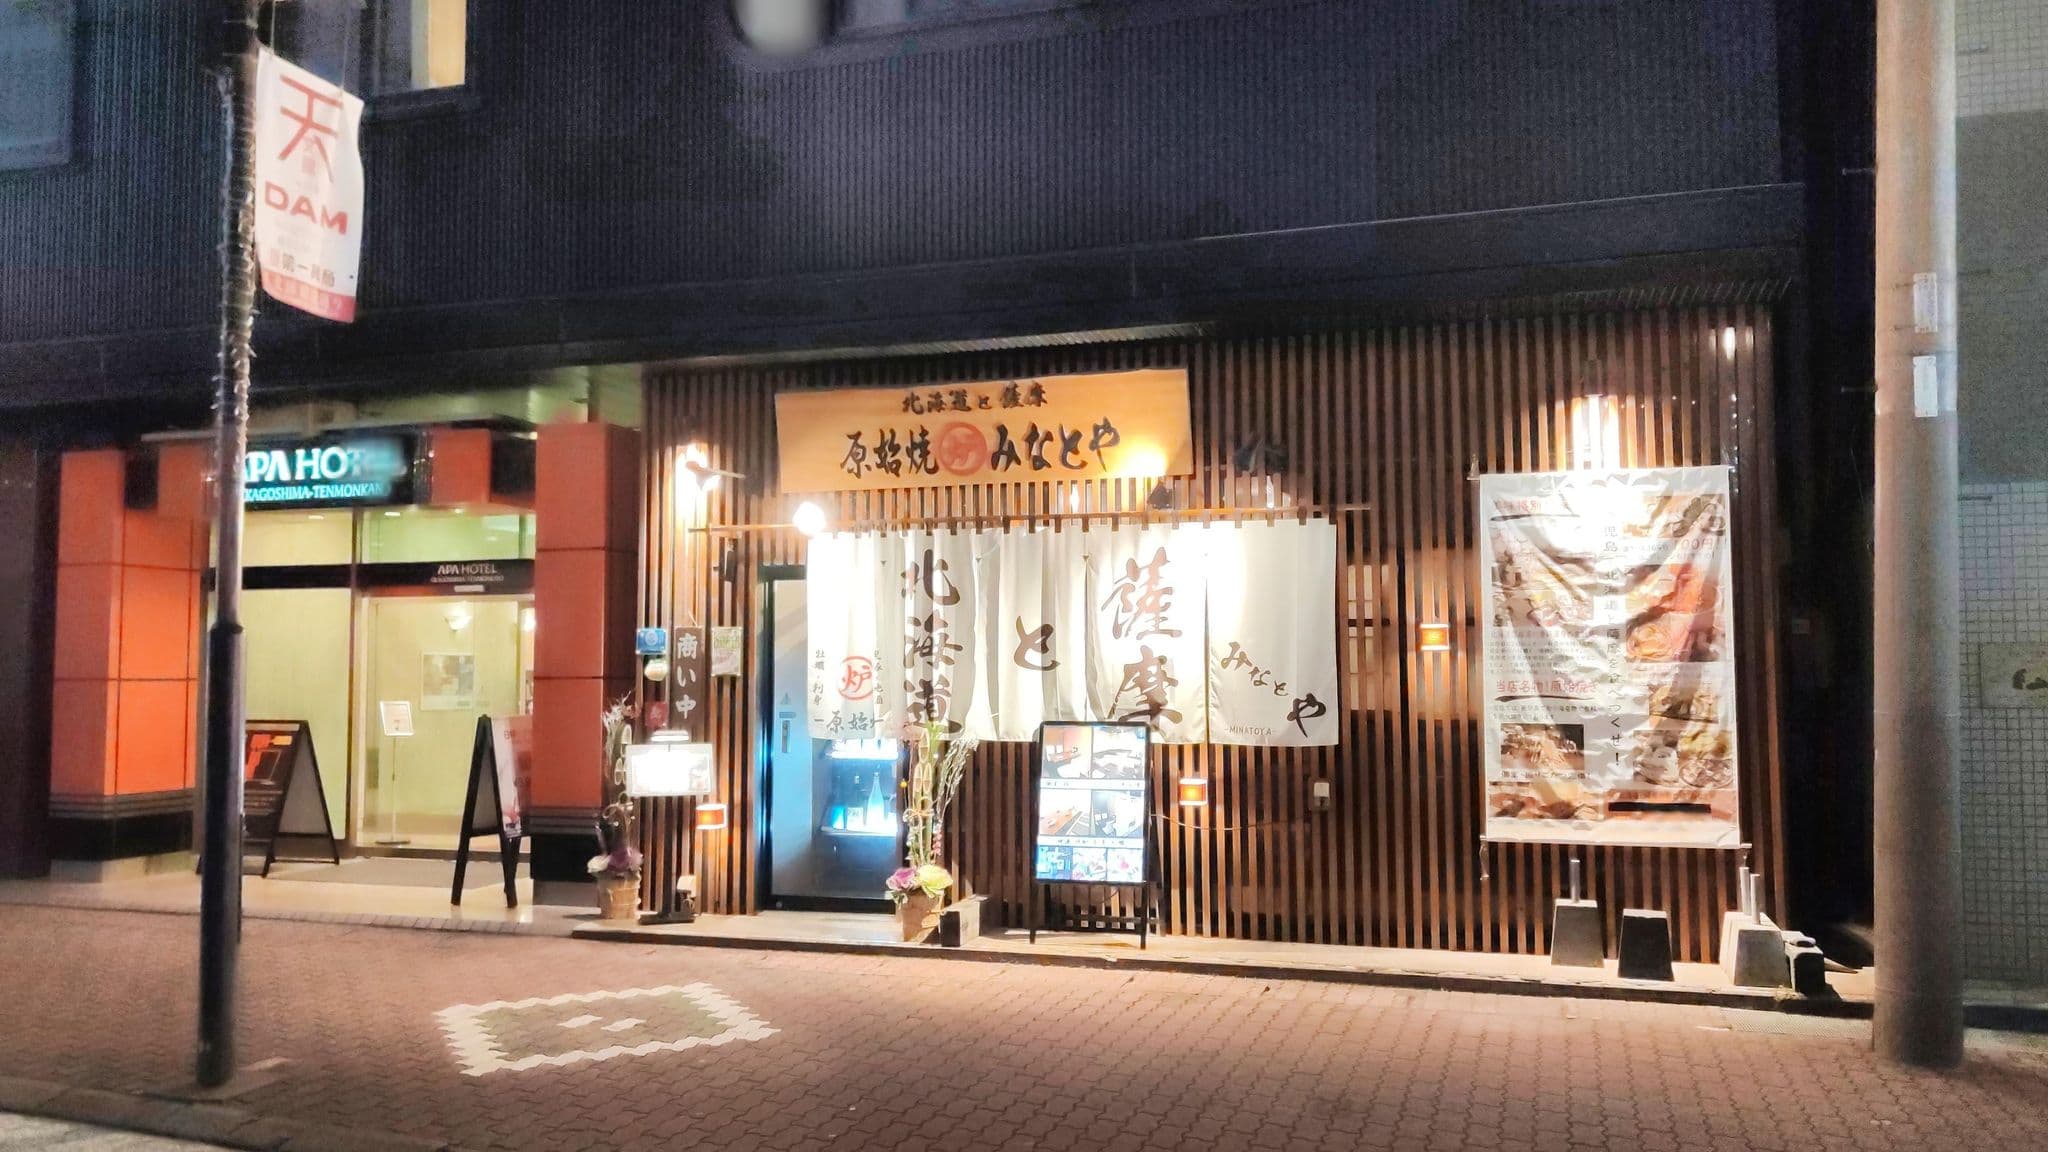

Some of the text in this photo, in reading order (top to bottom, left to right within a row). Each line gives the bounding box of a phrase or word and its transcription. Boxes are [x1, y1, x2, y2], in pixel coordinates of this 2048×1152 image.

[264, 181, 348, 235] DAM
[991, 416, 1121, 473] みなとや
[437, 563, 498, 575] APA HOTEL
[675, 632, 698, 720] 商い中
[901, 549, 963, 734] 北海道
[1013, 615, 1059, 672] と
[1101, 547, 1183, 737] 薩摩
[1220, 641, 1327, 738] みなとや
